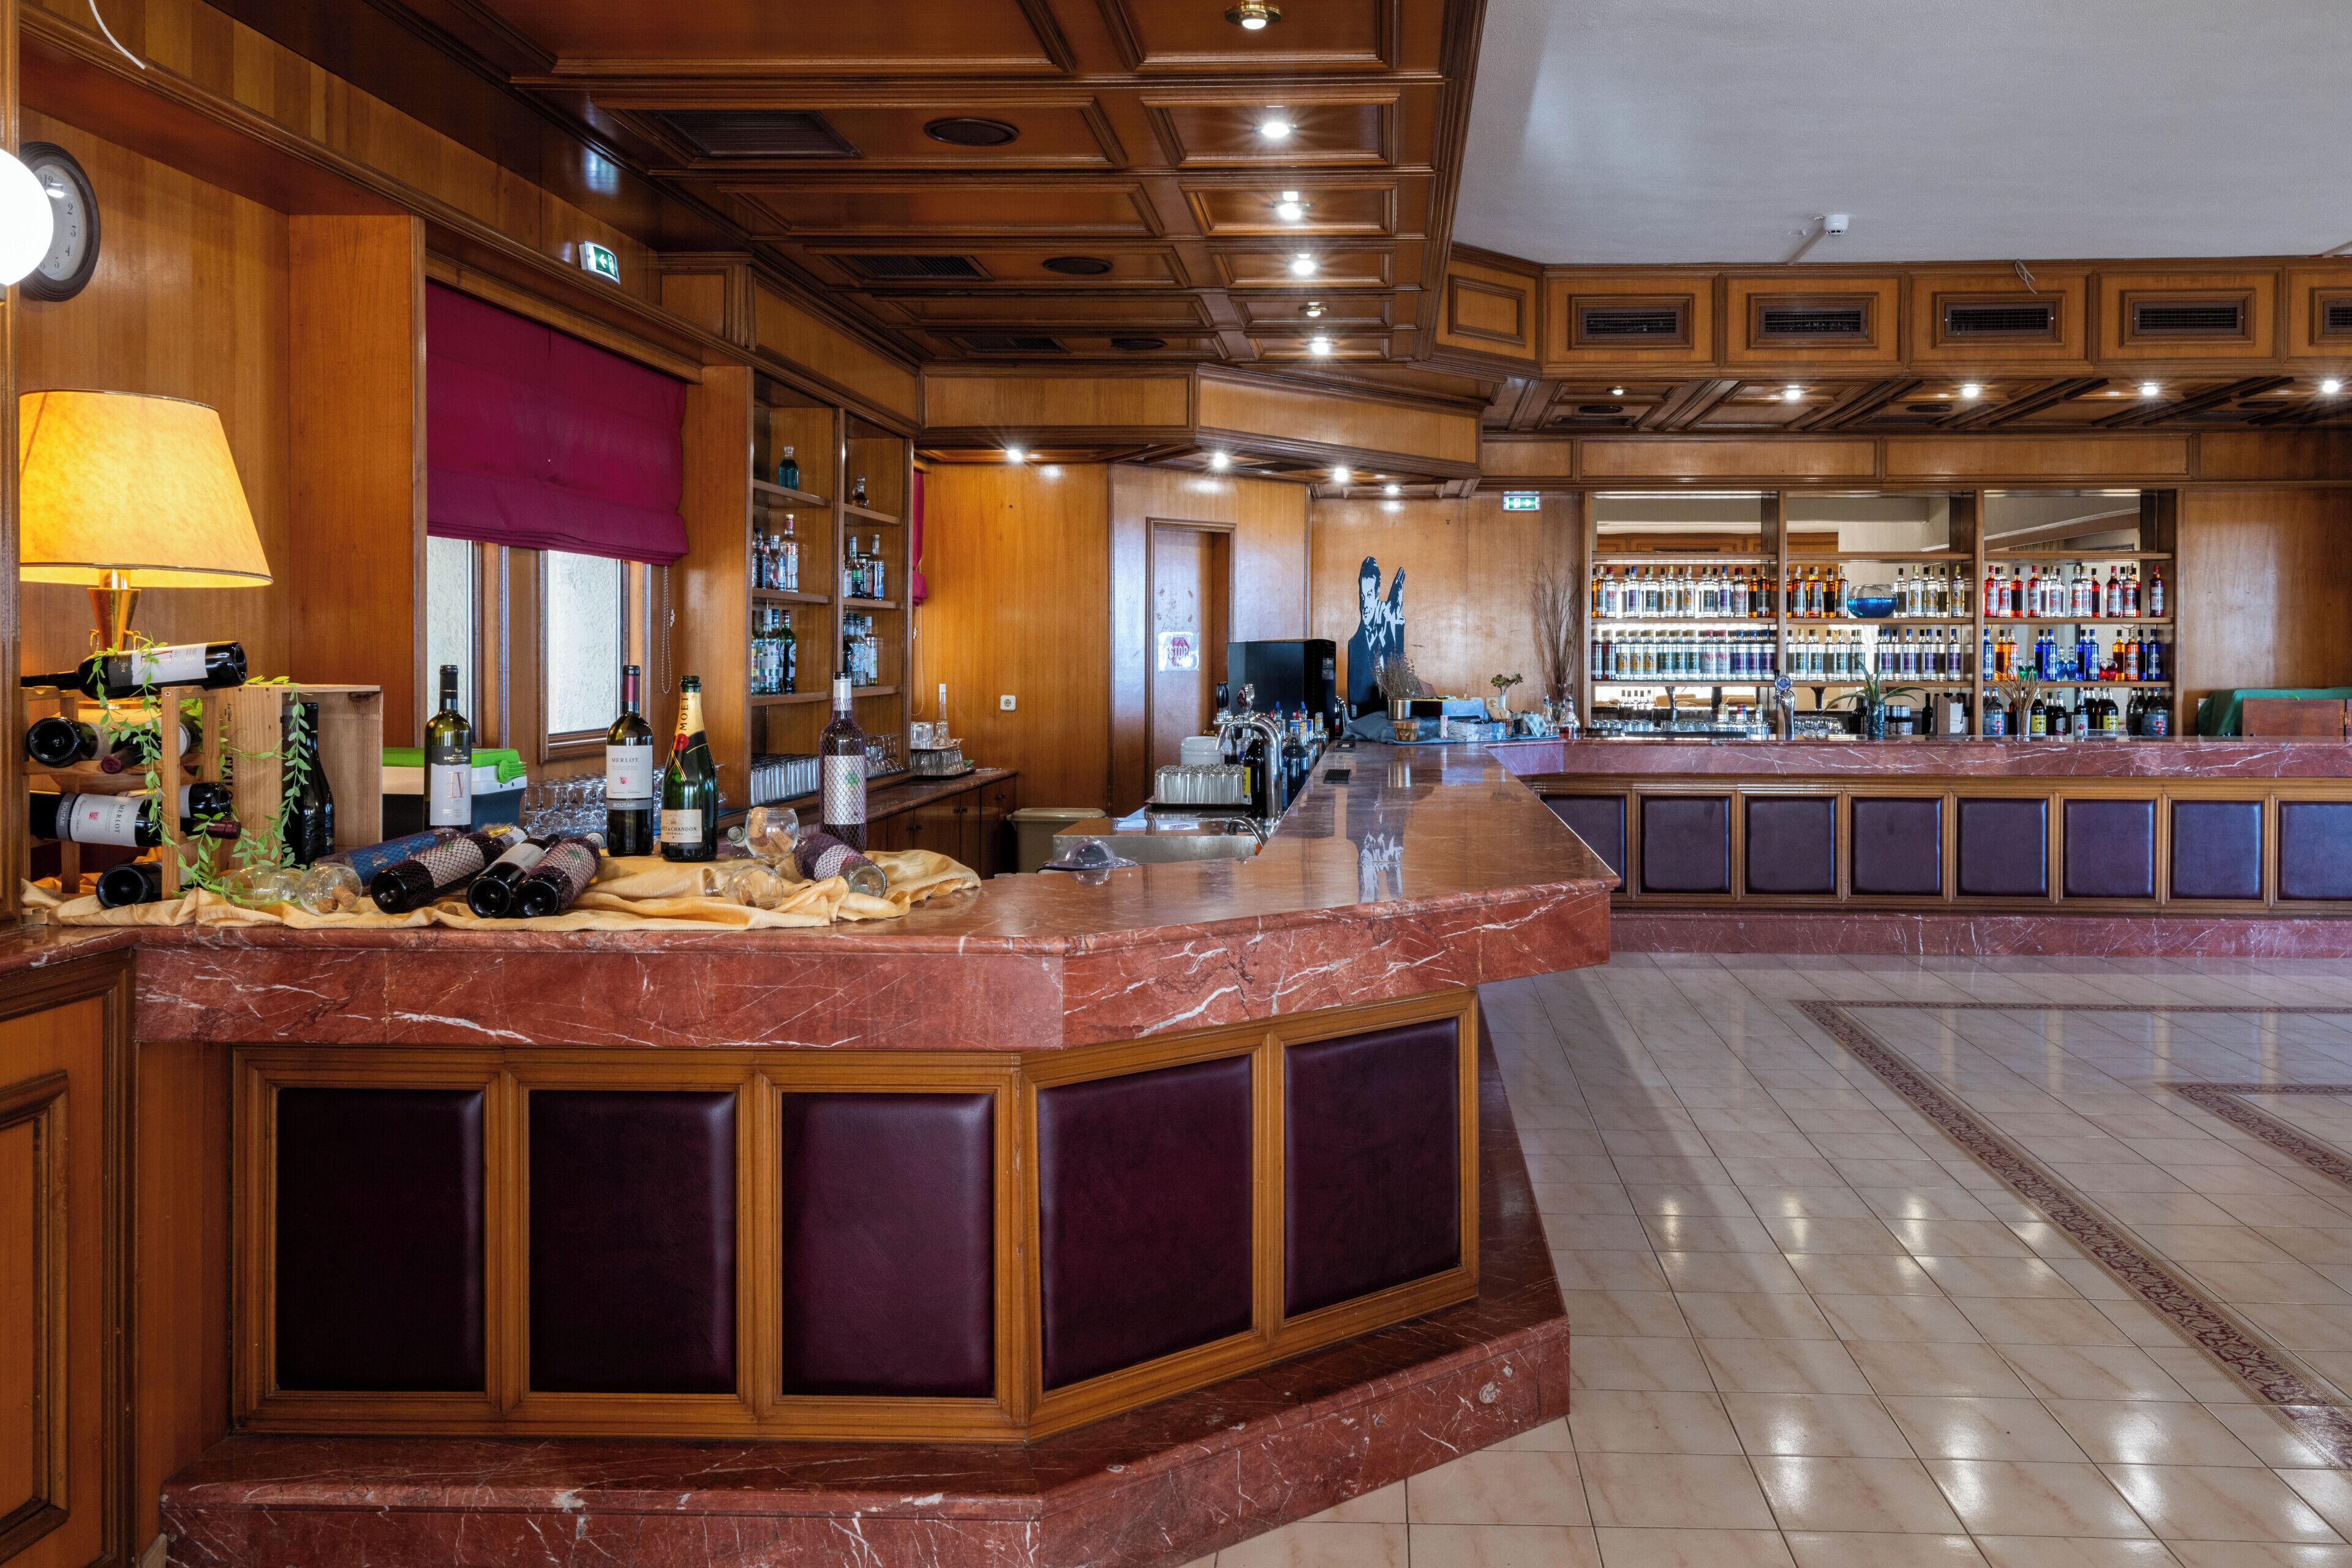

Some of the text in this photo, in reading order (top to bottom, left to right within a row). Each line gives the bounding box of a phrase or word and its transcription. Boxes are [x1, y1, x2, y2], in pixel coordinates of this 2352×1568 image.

[43, 174, 54, 187] 12
[67, 203, 74, 215] 2
[54, 257, 60, 268] 5
[1169, 646, 1189, 658] STOP
[447, 771, 467, 798] IV
[59, 802, 69, 826] BOUTARI
[114, 804, 126, 834] MERLOT
